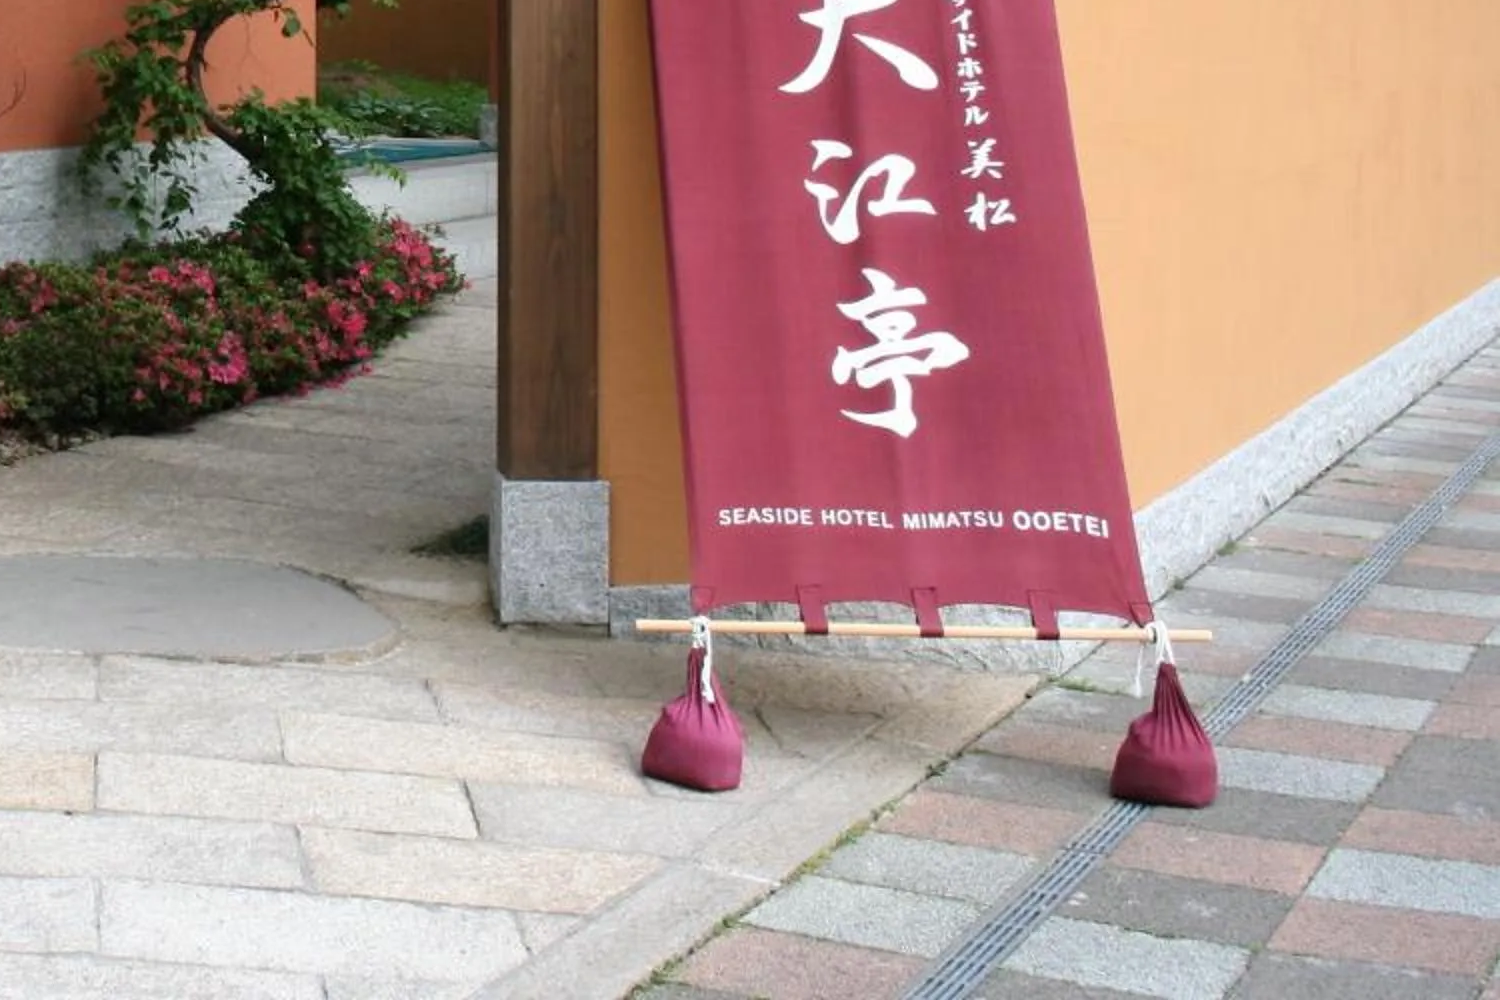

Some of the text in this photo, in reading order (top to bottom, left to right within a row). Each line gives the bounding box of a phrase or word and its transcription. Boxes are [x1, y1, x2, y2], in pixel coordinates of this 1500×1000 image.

[960, 138, 1017, 232] 美松
[718, 507, 1110, 538] SEASIDE HOTEL MIMATSU OOETEI
